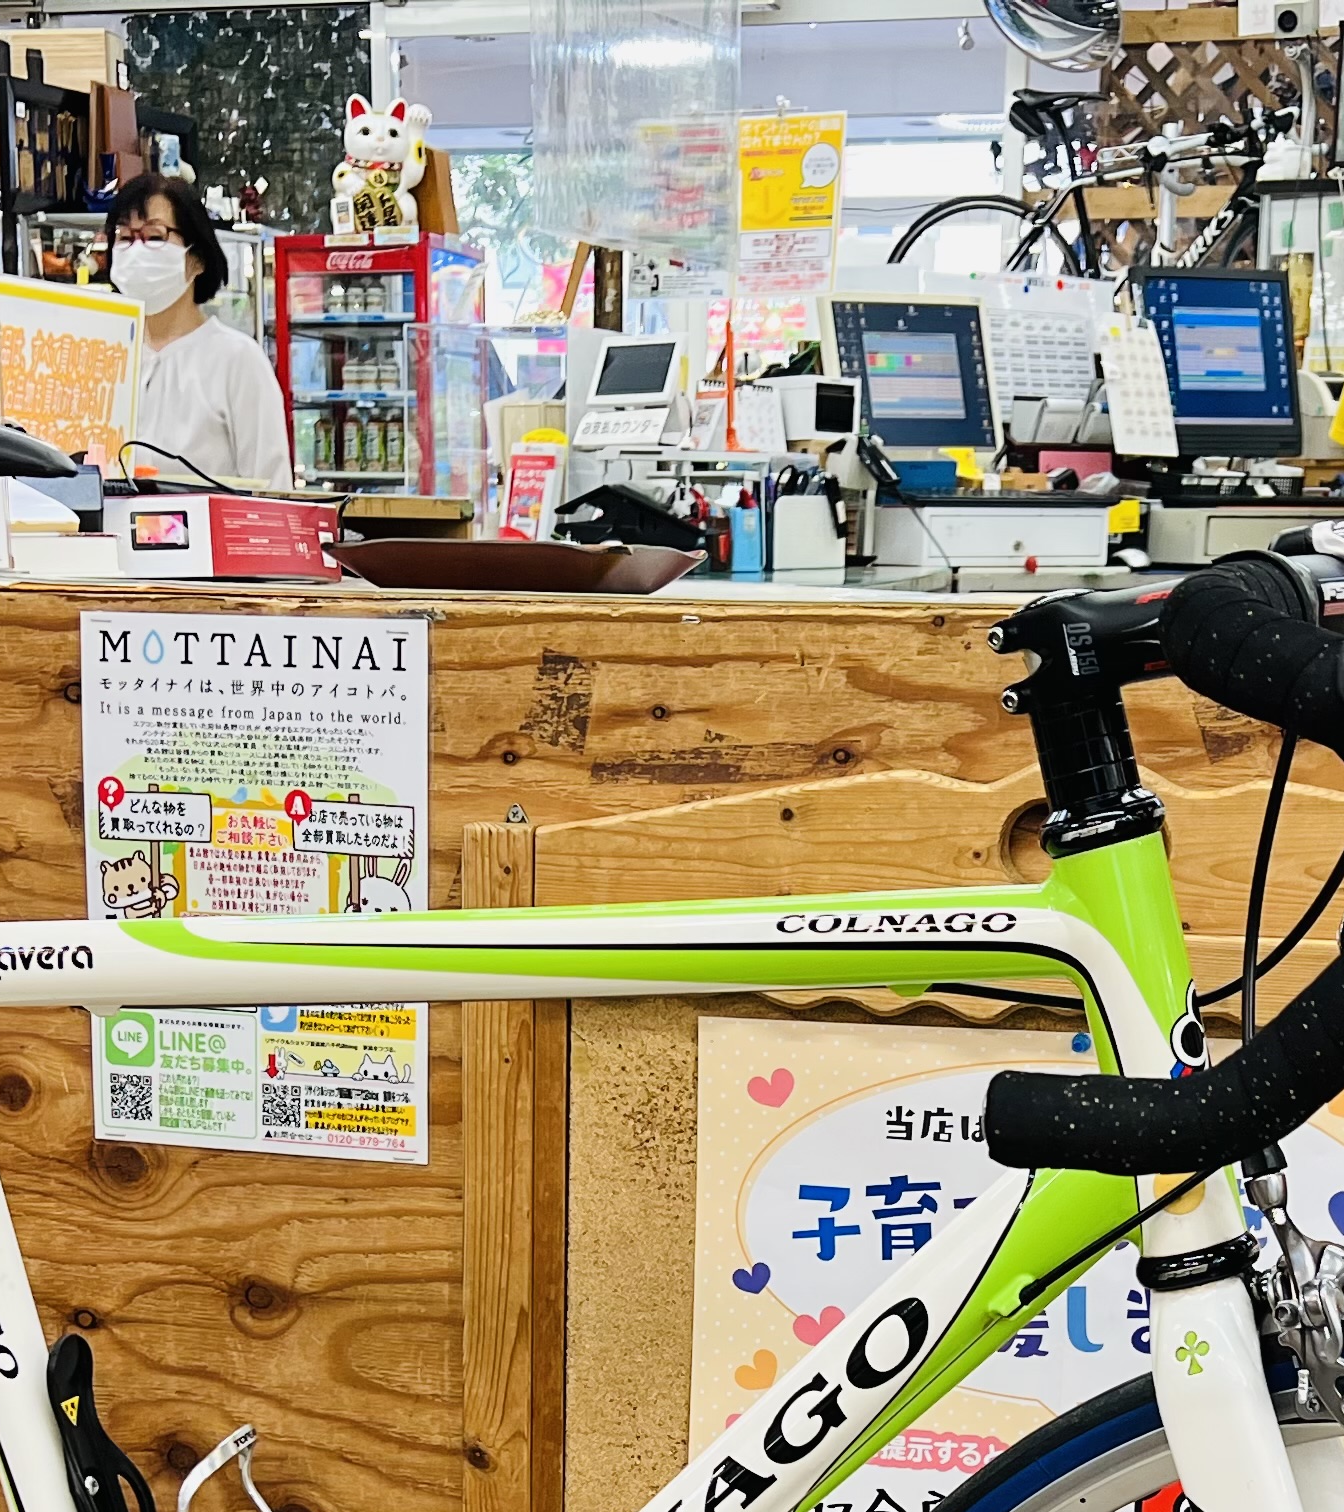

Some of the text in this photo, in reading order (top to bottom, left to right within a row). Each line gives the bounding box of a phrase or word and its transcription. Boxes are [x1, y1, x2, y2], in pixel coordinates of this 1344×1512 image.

[582, 419, 660, 435] お支払カウンター
[98, 677, 409, 702] モッタイナイは、世界中のアイコトバ。
[99, 701, 408, 726] It is a message from Japan to the world.
[128, 799, 187, 817] どんな物を
[308, 808, 404, 830] お店で売っている物は
[110, 817, 206, 838] 買取ってくれるの？
[226, 814, 277, 831] お気軽に
[216, 829, 288, 847] ご相談下さい
[301, 829, 408, 851] 全部買取したものだよ！
[775, 911, 1018, 934] COLNAGO
[117, 1029, 143, 1044] LINE
[159, 1030, 227, 1054] LINE@
[159, 1054, 253, 1075] 友だち募集中。
[792, 1174, 977, 1261] 子育
[872, 1434, 1006, 1467] 提示すると
